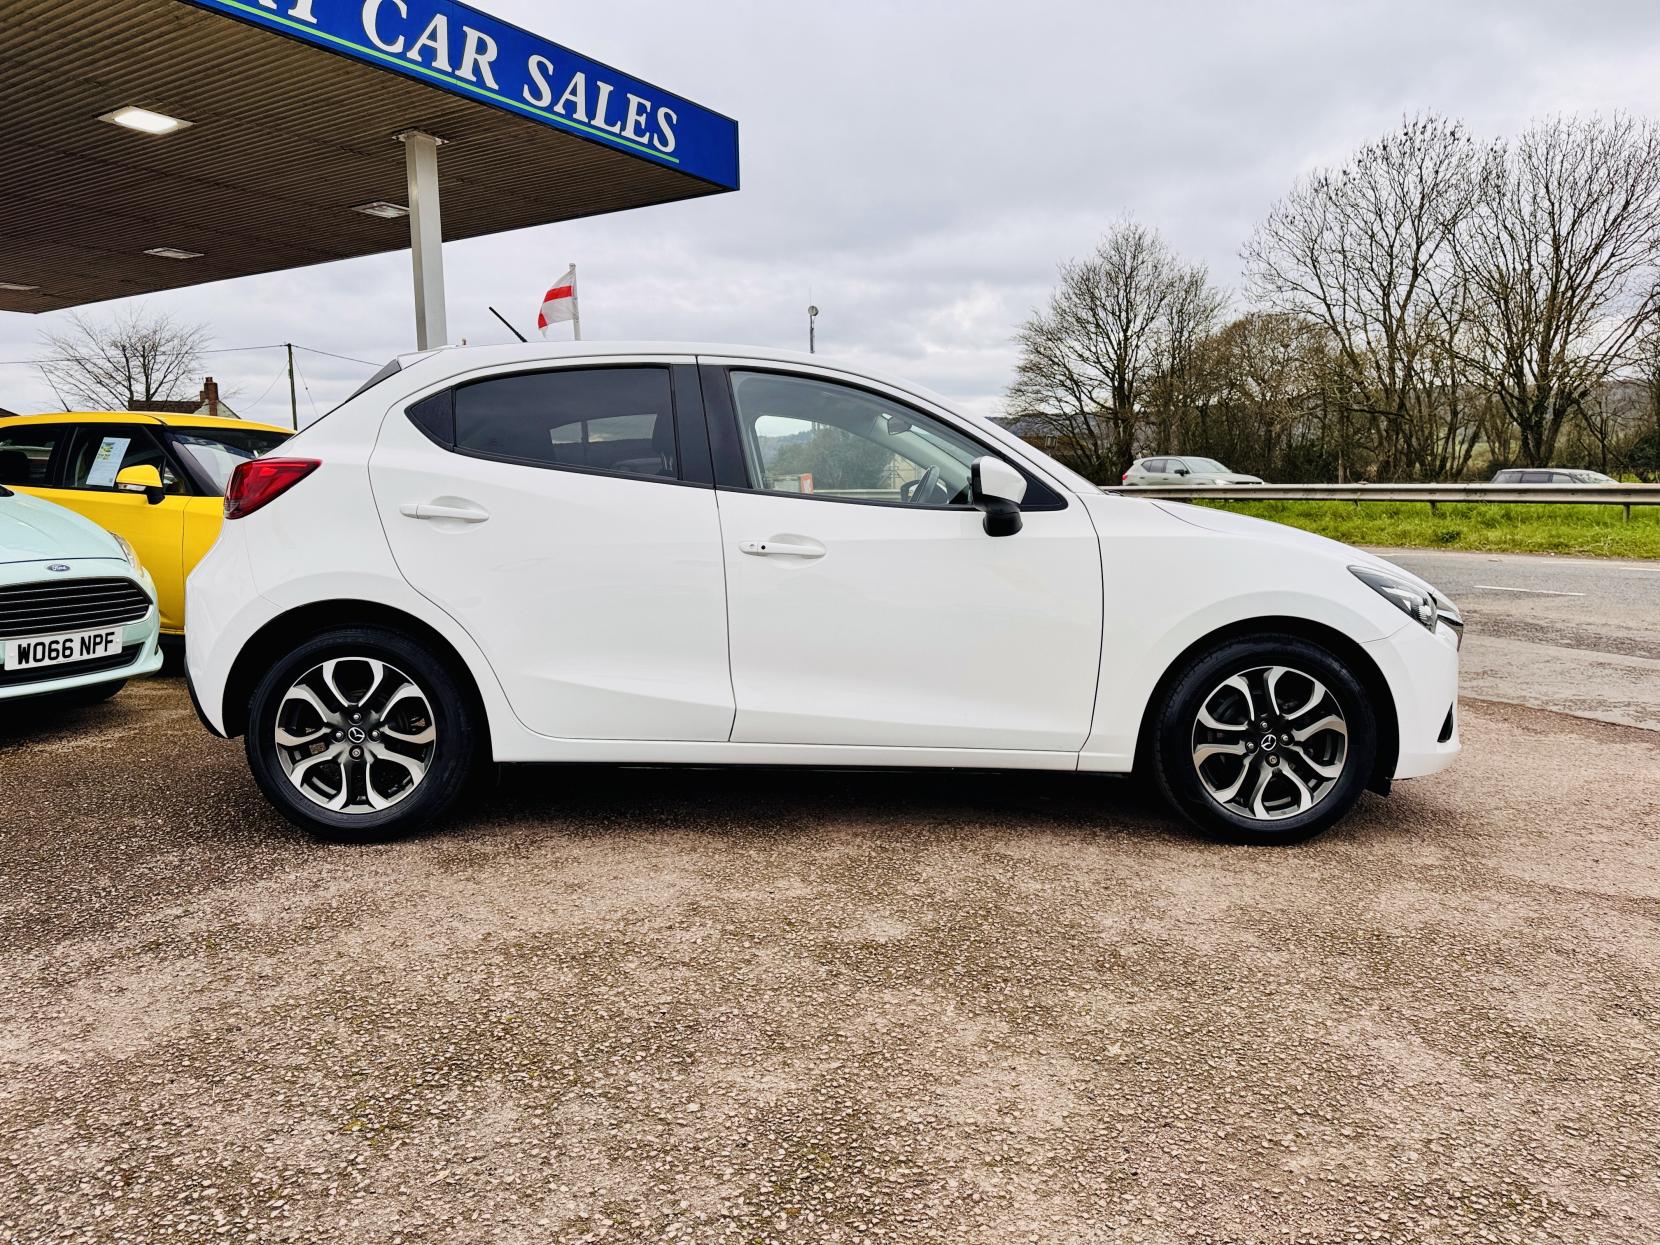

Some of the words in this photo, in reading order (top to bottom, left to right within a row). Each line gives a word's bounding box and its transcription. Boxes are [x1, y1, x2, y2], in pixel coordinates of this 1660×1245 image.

[361, 0, 499, 90] CAR
[523, 55, 678, 153] SALES
[17, 638, 74, 665] WO66
[79, 631, 115, 657] NPF
